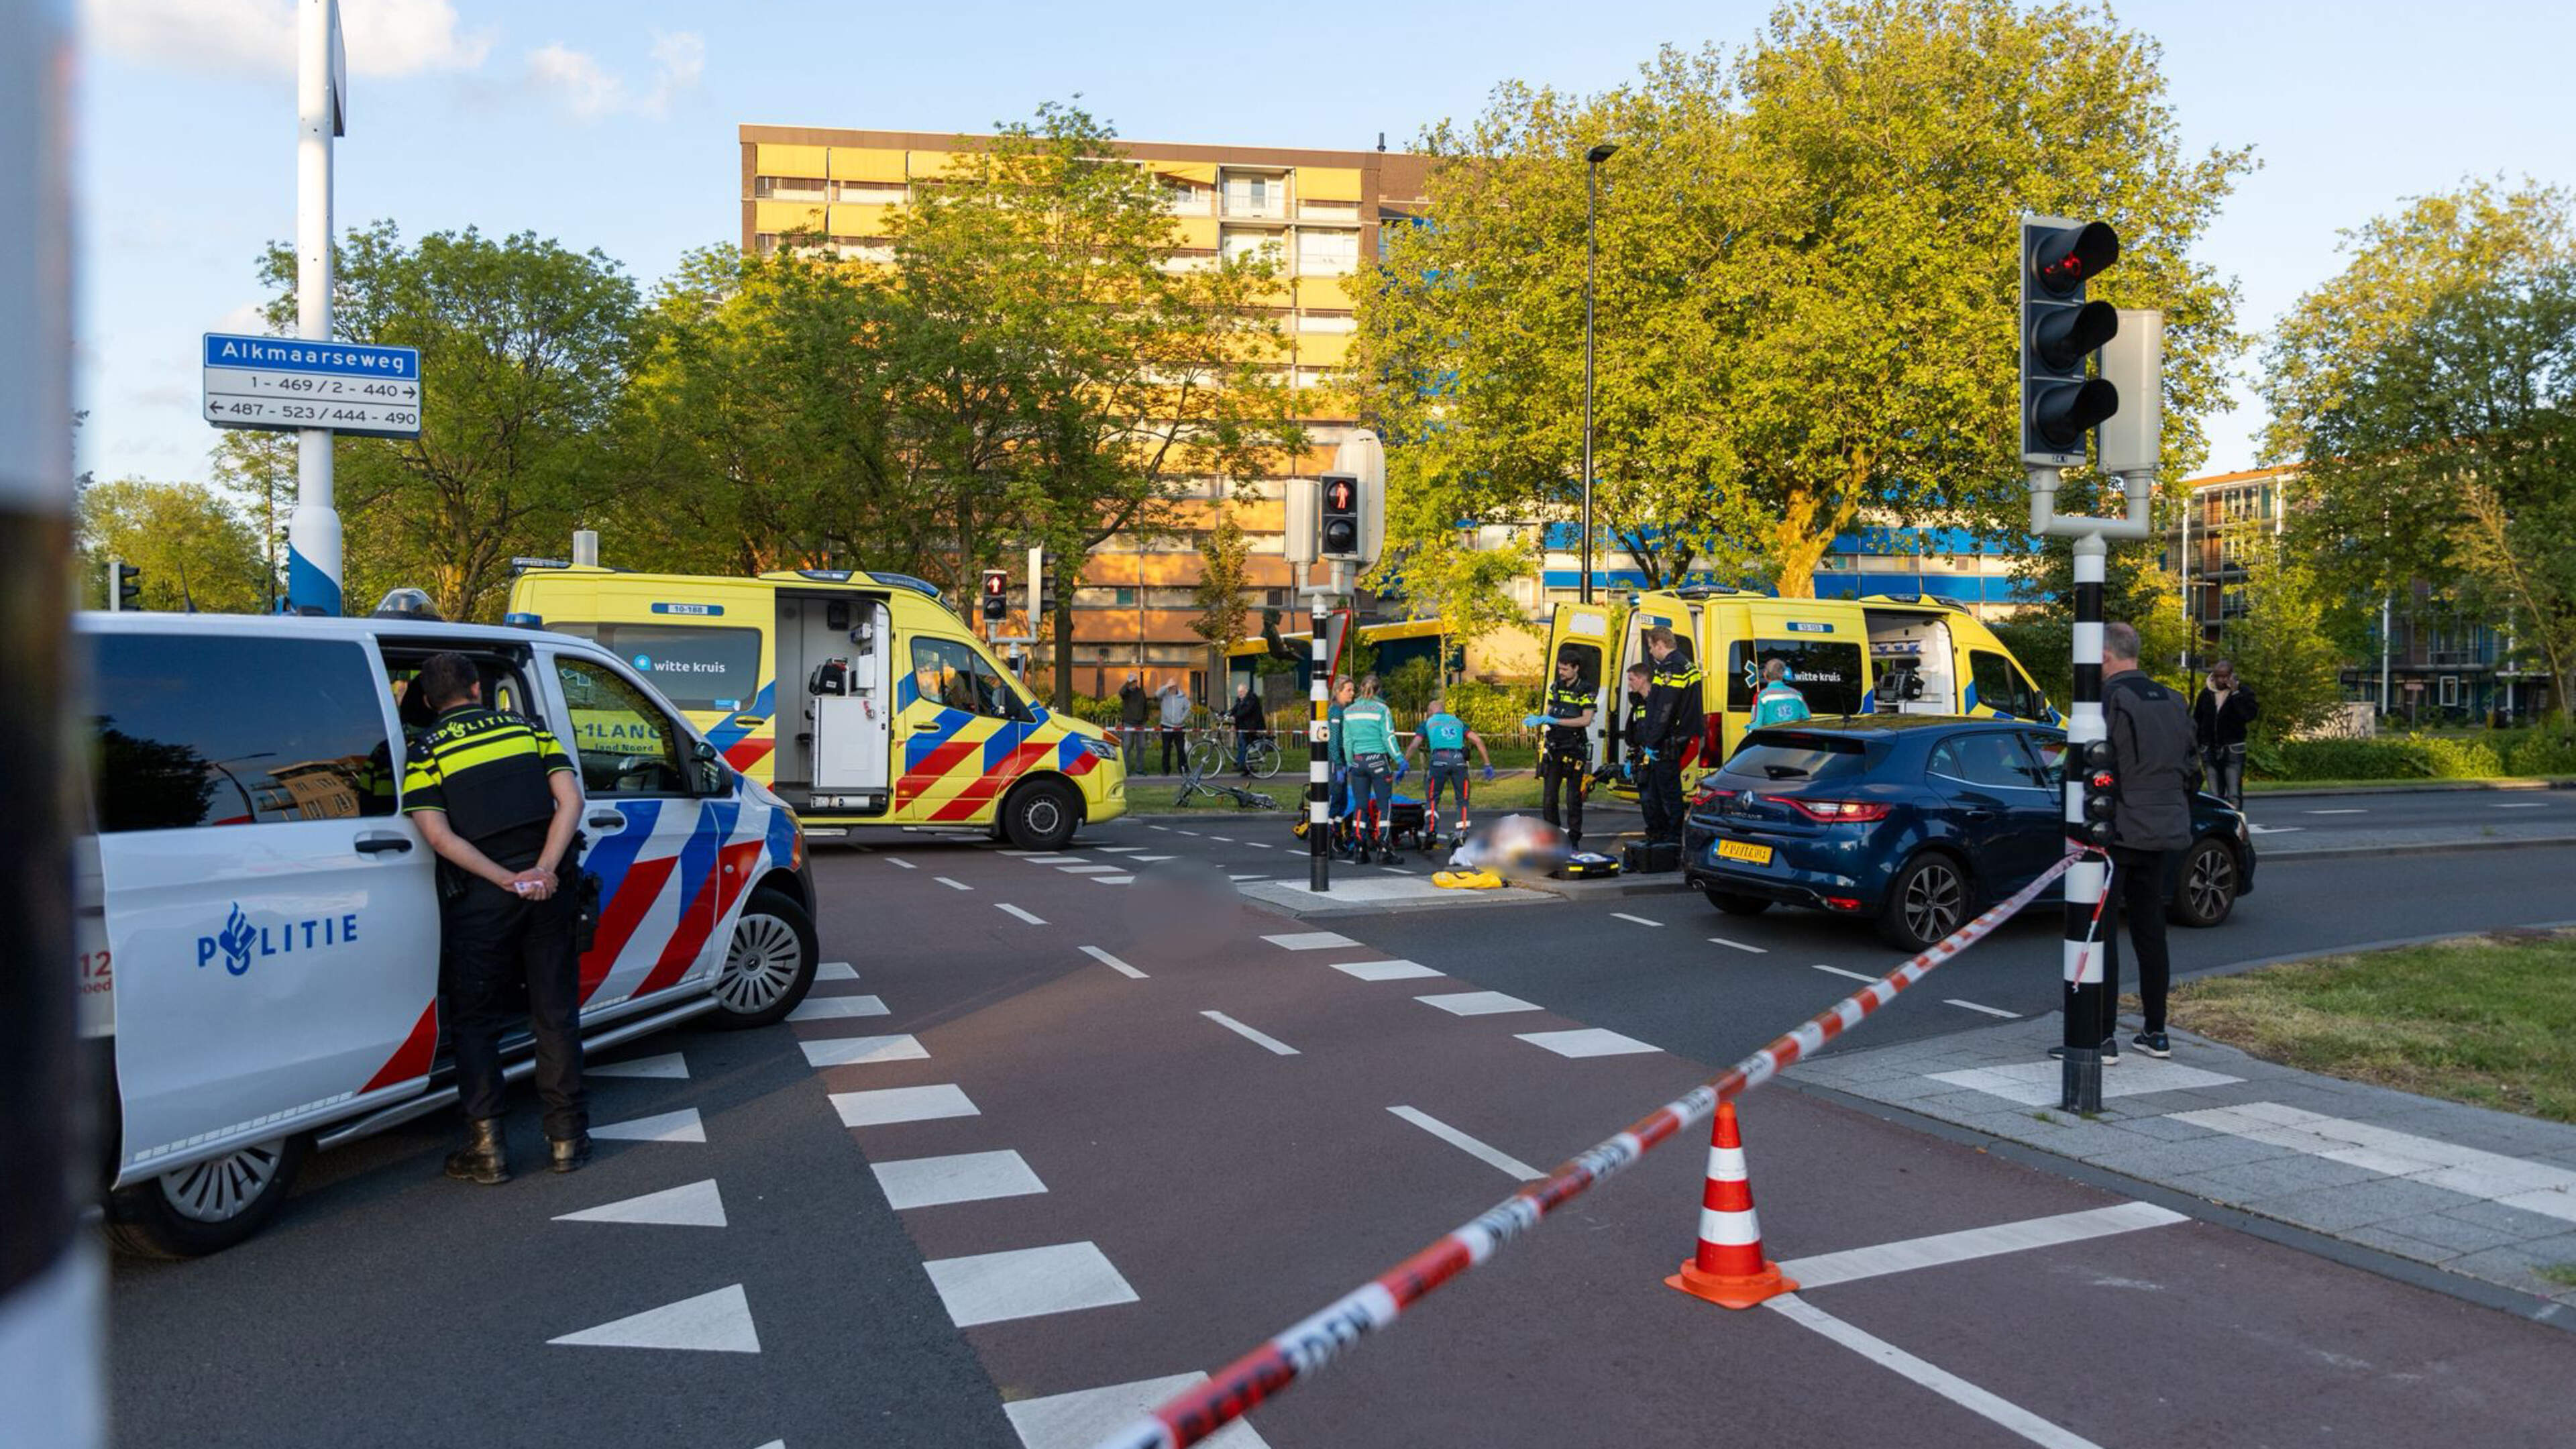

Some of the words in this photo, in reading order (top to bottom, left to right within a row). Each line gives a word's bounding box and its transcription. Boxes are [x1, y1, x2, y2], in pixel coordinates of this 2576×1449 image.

[221, 341, 405, 374] Alkmaarseweg
[252, 376, 258, 388] 1
[279, 378, 313, 391] 469
[317, 380, 327, 393] /
[332, 382, 343, 394] 2
[363, 384, 398, 397] 440
[229, 403, 264, 416] 487
[282, 405, 315, 419] 523
[319, 408, 329, 420] /
[332, 409, 366, 422] 444
[384, 412, 417, 425] 490
[654, 660, 690, 672] witte
[693, 661, 725, 673] kruis
[1794, 672, 1818, 682] witte
[1819, 672, 1841, 682] kruis
[198, 914, 358, 976] POLITIE
[80, 951, 112, 977] 12
